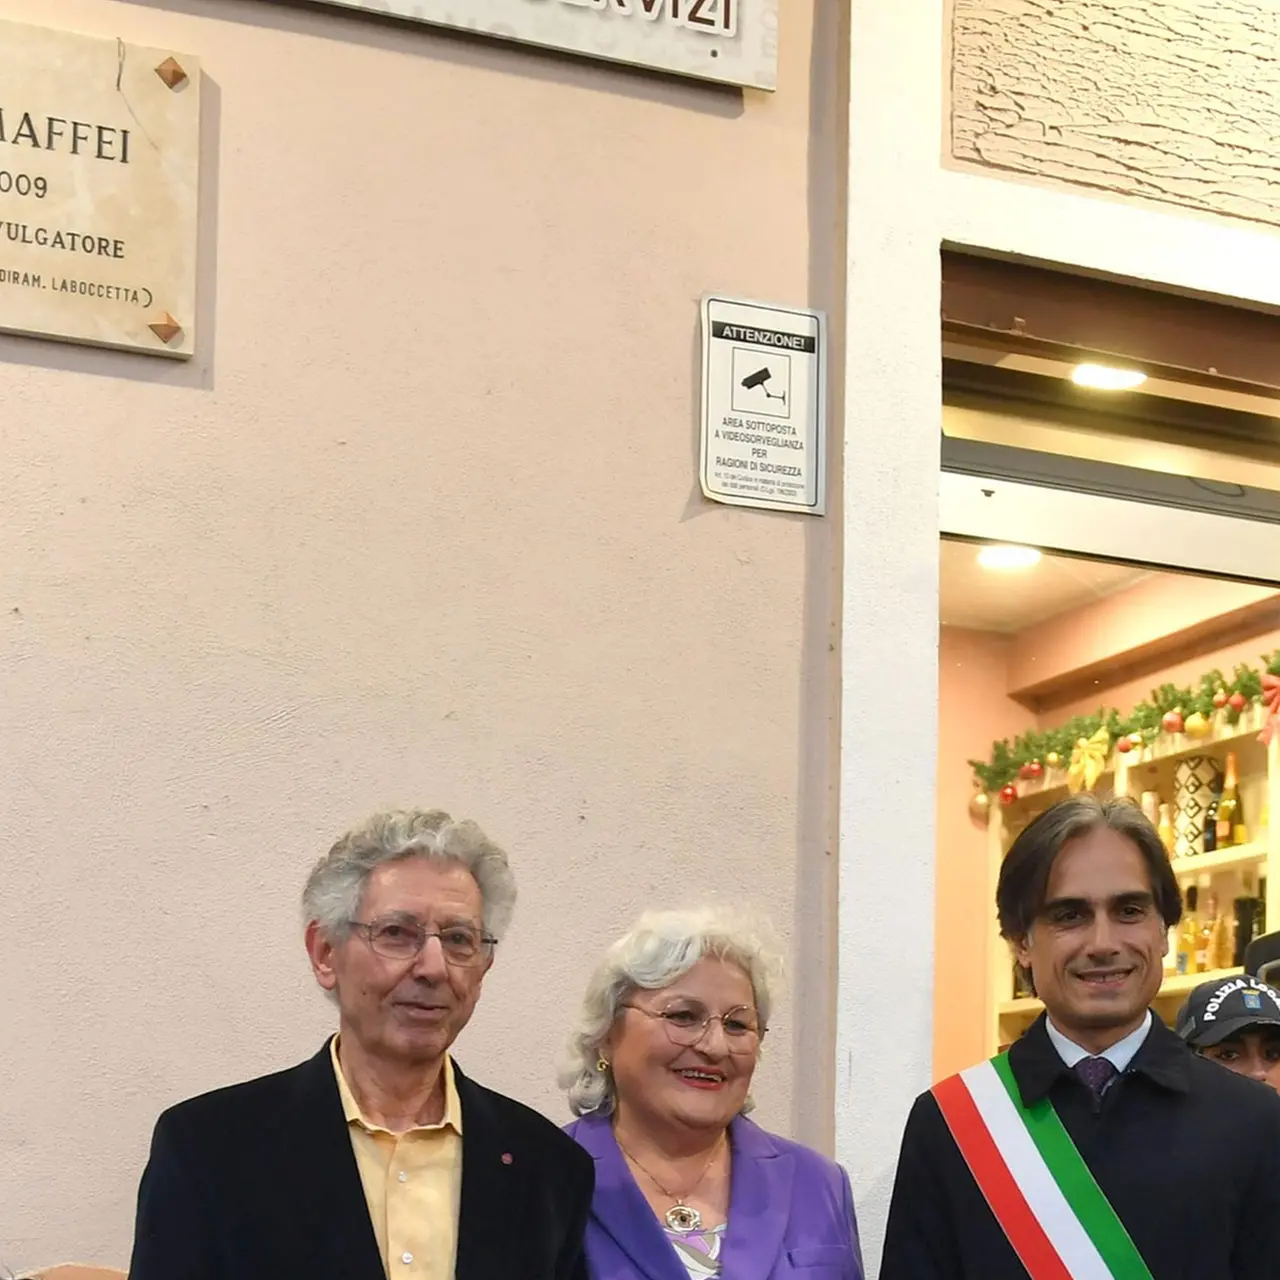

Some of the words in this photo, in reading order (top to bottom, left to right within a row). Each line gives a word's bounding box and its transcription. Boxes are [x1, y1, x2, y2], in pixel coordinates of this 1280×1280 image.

[52, 276, 154, 308] LABOCCETTA)
[722, 325, 805, 350] ATTENZIONE!
[714, 429, 720, 439] A
[722, 417, 744, 429] AREA
[745, 419, 798, 437] SOTTOPOSTA
[751, 447, 768, 459] PER
[715, 456, 749, 470] RAGIONI
[750, 461, 758, 471] DI
[759, 462, 803, 477] SICUREZZA
[1203, 978, 1248, 1021] POLIZIA
